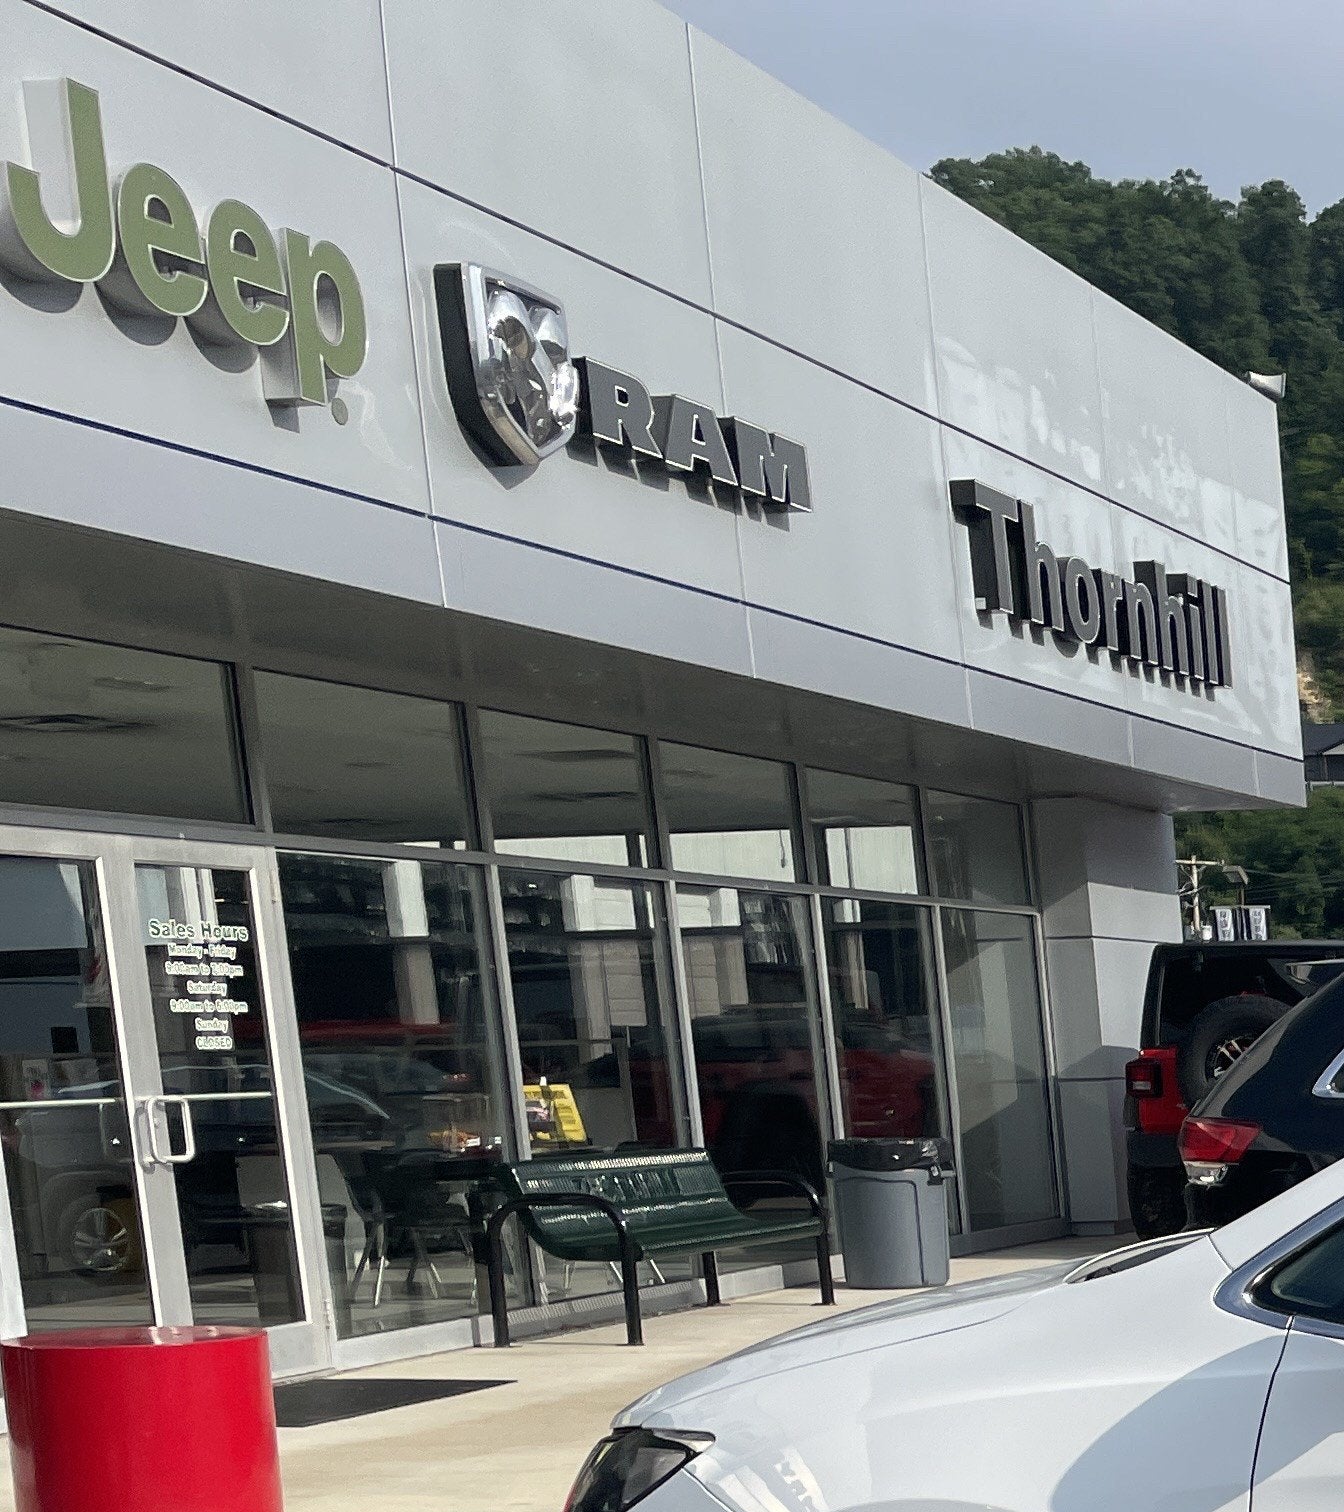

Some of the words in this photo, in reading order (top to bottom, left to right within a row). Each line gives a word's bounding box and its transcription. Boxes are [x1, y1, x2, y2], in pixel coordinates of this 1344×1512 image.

[5, 77, 368, 408] Jeep
[576, 356, 813, 513] RAM
[949, 478, 1233, 689] Thornhill
[149, 919, 196, 938] Sales
[200, 921, 249, 941] Hours
[187, 980, 227, 996] Saturday
[195, 1017, 228, 1033] Sunday
[196, 1036, 233, 1050] CLOSED
